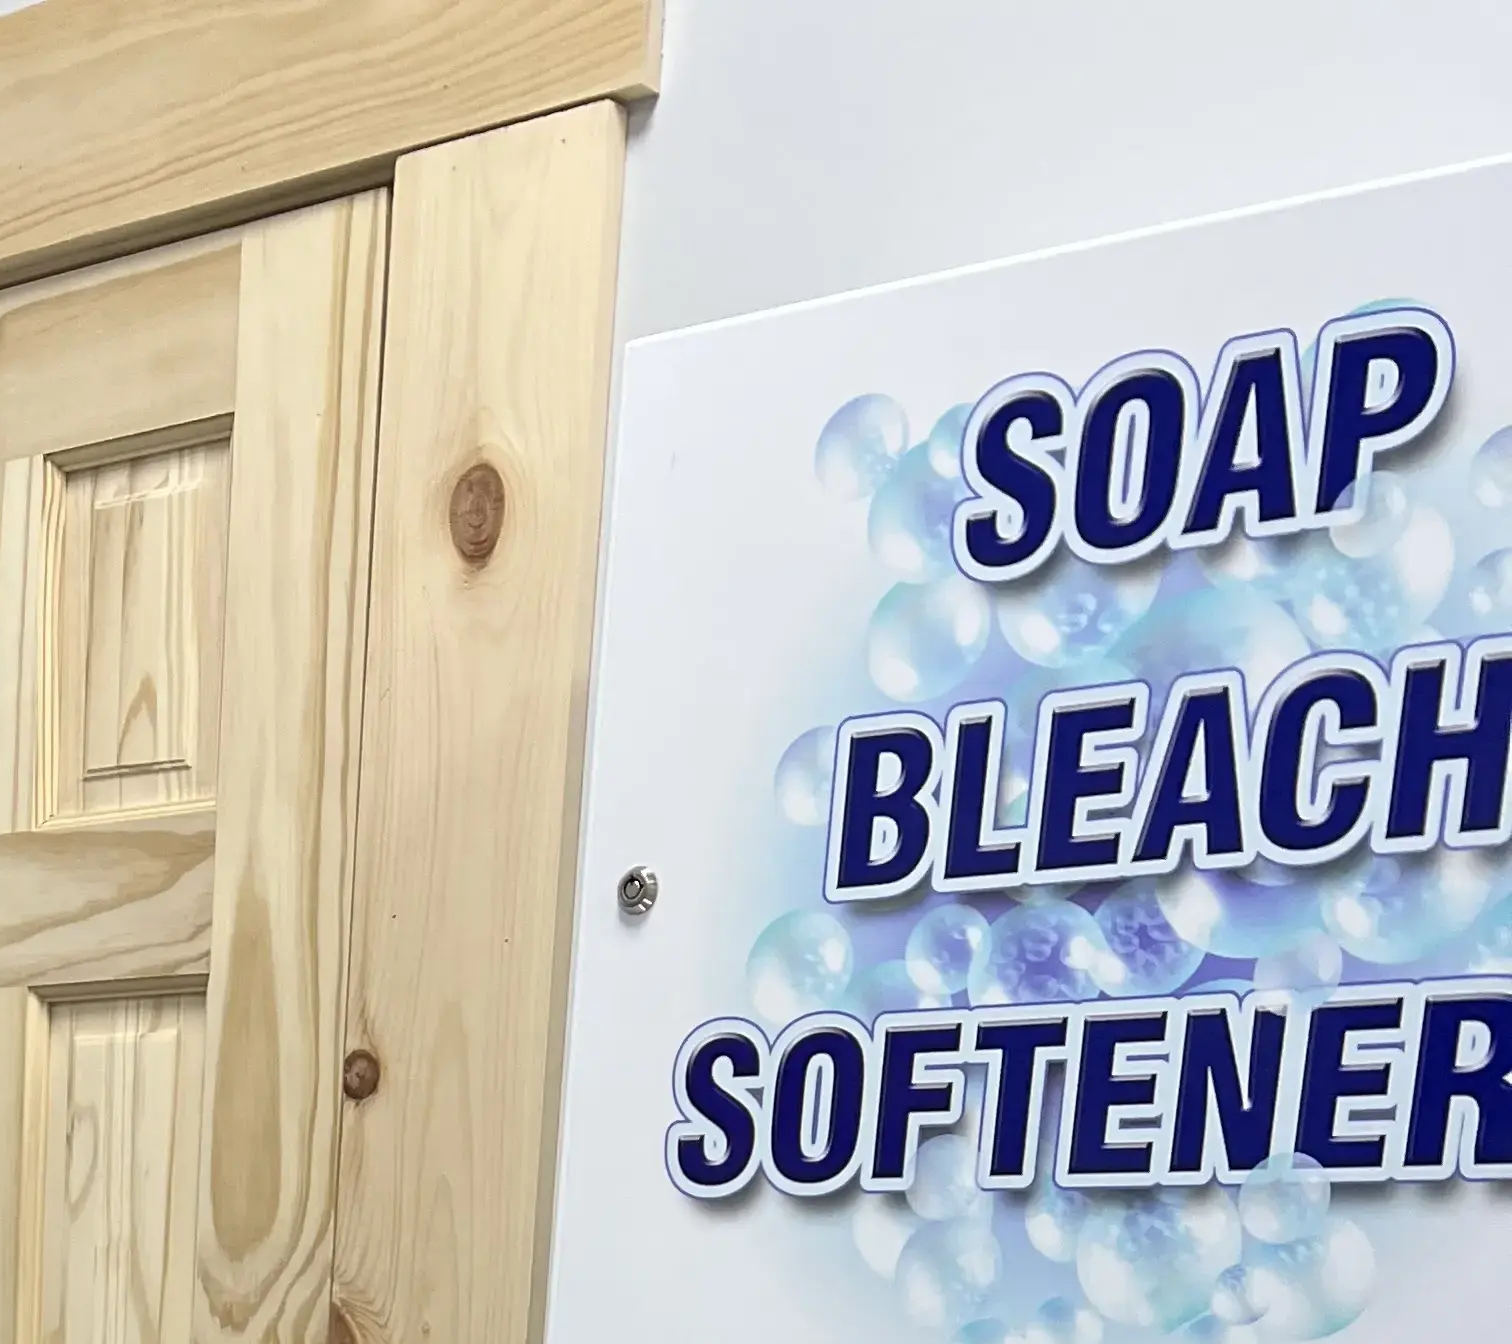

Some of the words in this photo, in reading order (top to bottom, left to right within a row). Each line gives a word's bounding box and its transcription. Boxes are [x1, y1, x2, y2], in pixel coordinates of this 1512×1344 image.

[958, 315, 1448, 576] SOAP
[830, 645, 1512, 895] BLEACH
[670, 988, 1512, 1195] SOFTENER
